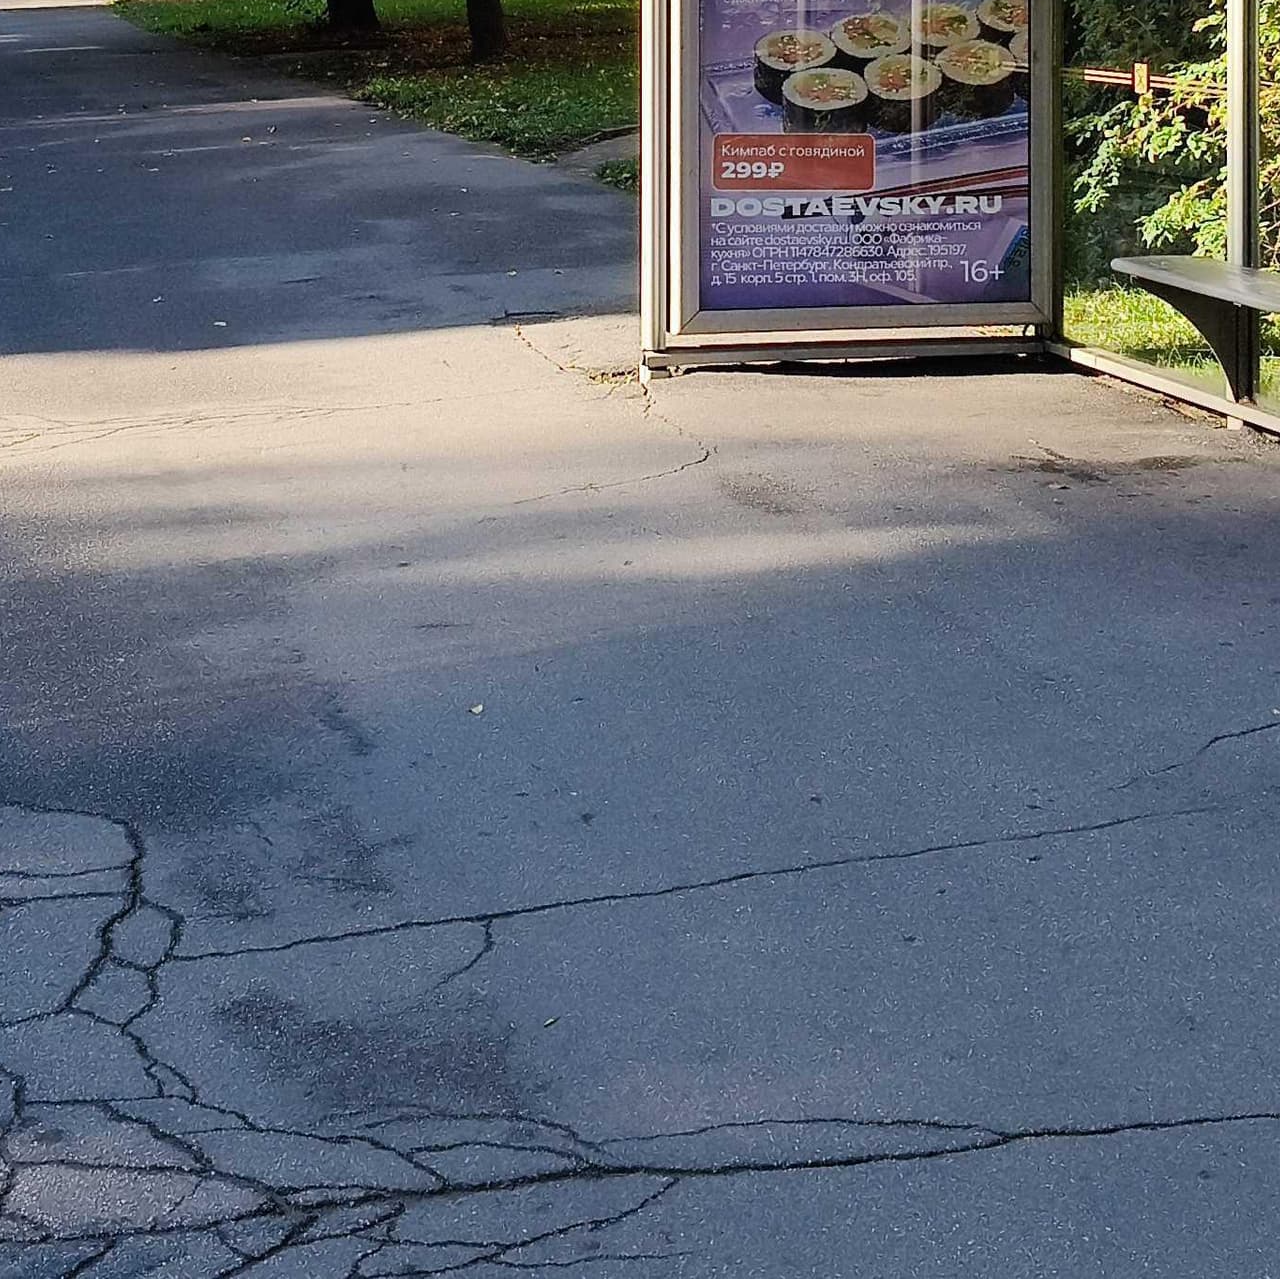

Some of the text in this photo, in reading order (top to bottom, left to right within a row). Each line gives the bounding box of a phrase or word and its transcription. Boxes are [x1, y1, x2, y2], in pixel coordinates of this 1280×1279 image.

[721, 143, 865, 158] Кимпаб с говядиной
[720, 162, 785, 179] 299₽
[710, 195, 1003, 218] DOSTAEVSKY.RU
[727, 223, 795, 236] условиями
[795, 222, 853, 234] доставки
[855, 221, 897, 232] можно
[898, 220, 981, 232] ознакомиться
[710, 236, 726, 246] на
[727, 234, 763, 246] сайте
[852, 233, 882, 245] ООО
[711, 248, 751, 262] кухня»
[752, 246, 788, 257] ОГРН
[833, 257, 932, 272] Кондратьевский
[960, 259, 1005, 283] 16+
[775, 271, 784, 283] 5
